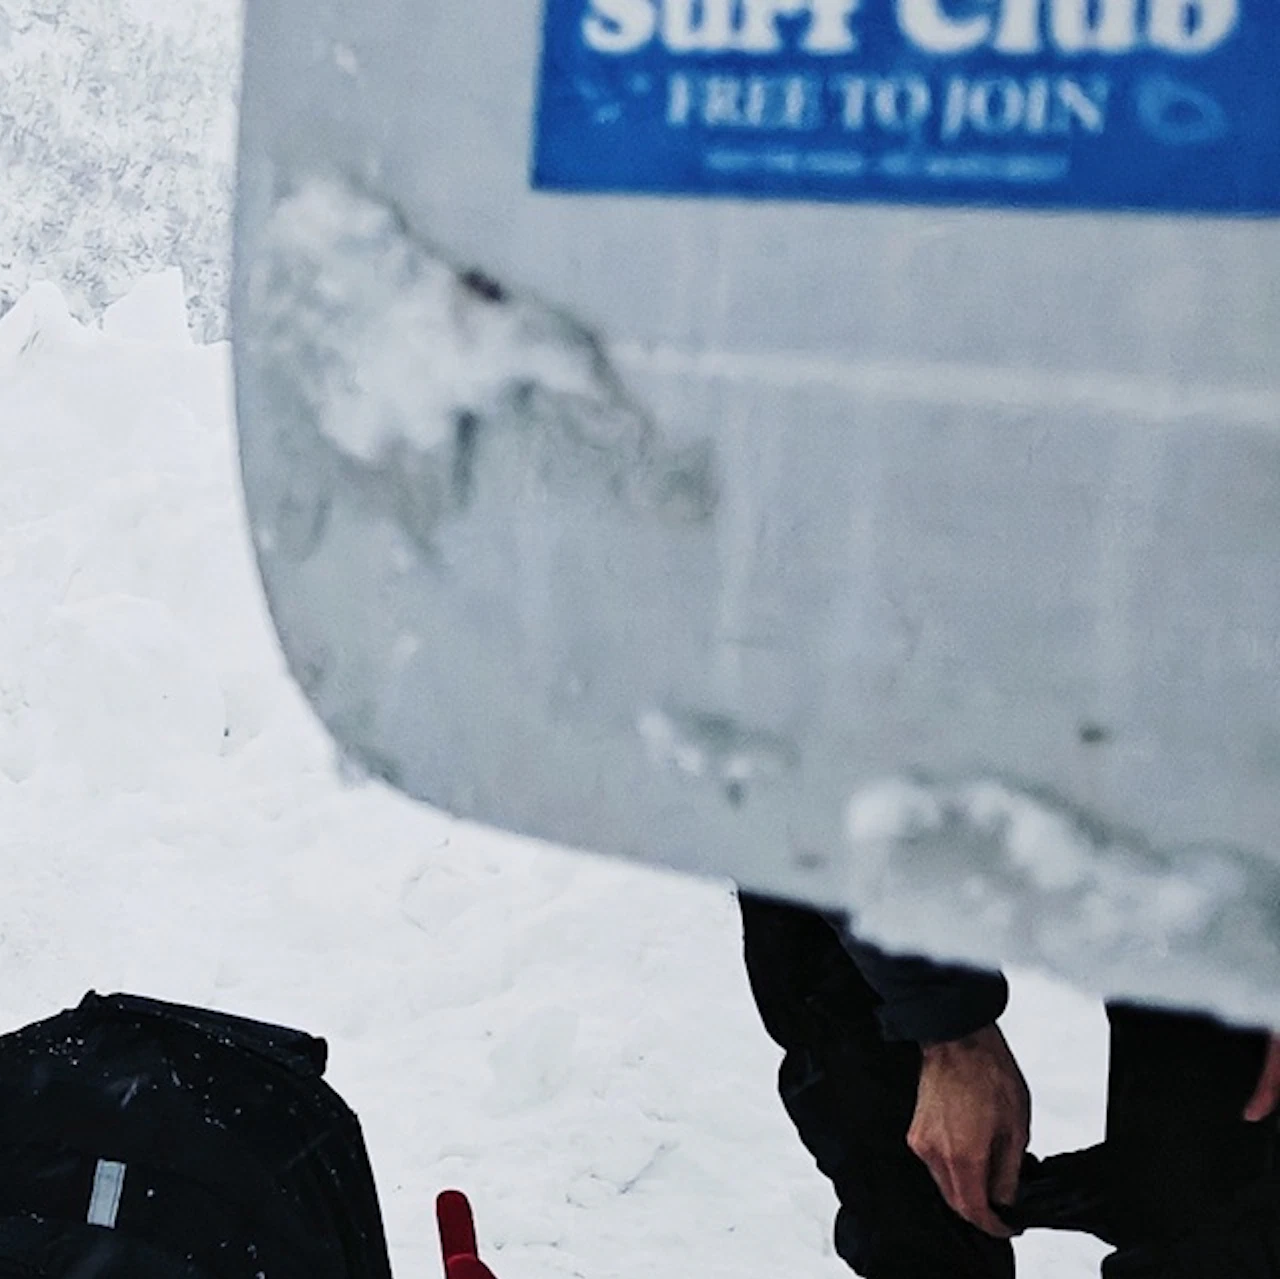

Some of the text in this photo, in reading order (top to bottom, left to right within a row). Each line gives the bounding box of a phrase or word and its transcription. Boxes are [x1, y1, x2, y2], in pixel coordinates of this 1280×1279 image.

[666, 71, 1111, 141] FREE TO JOIN
